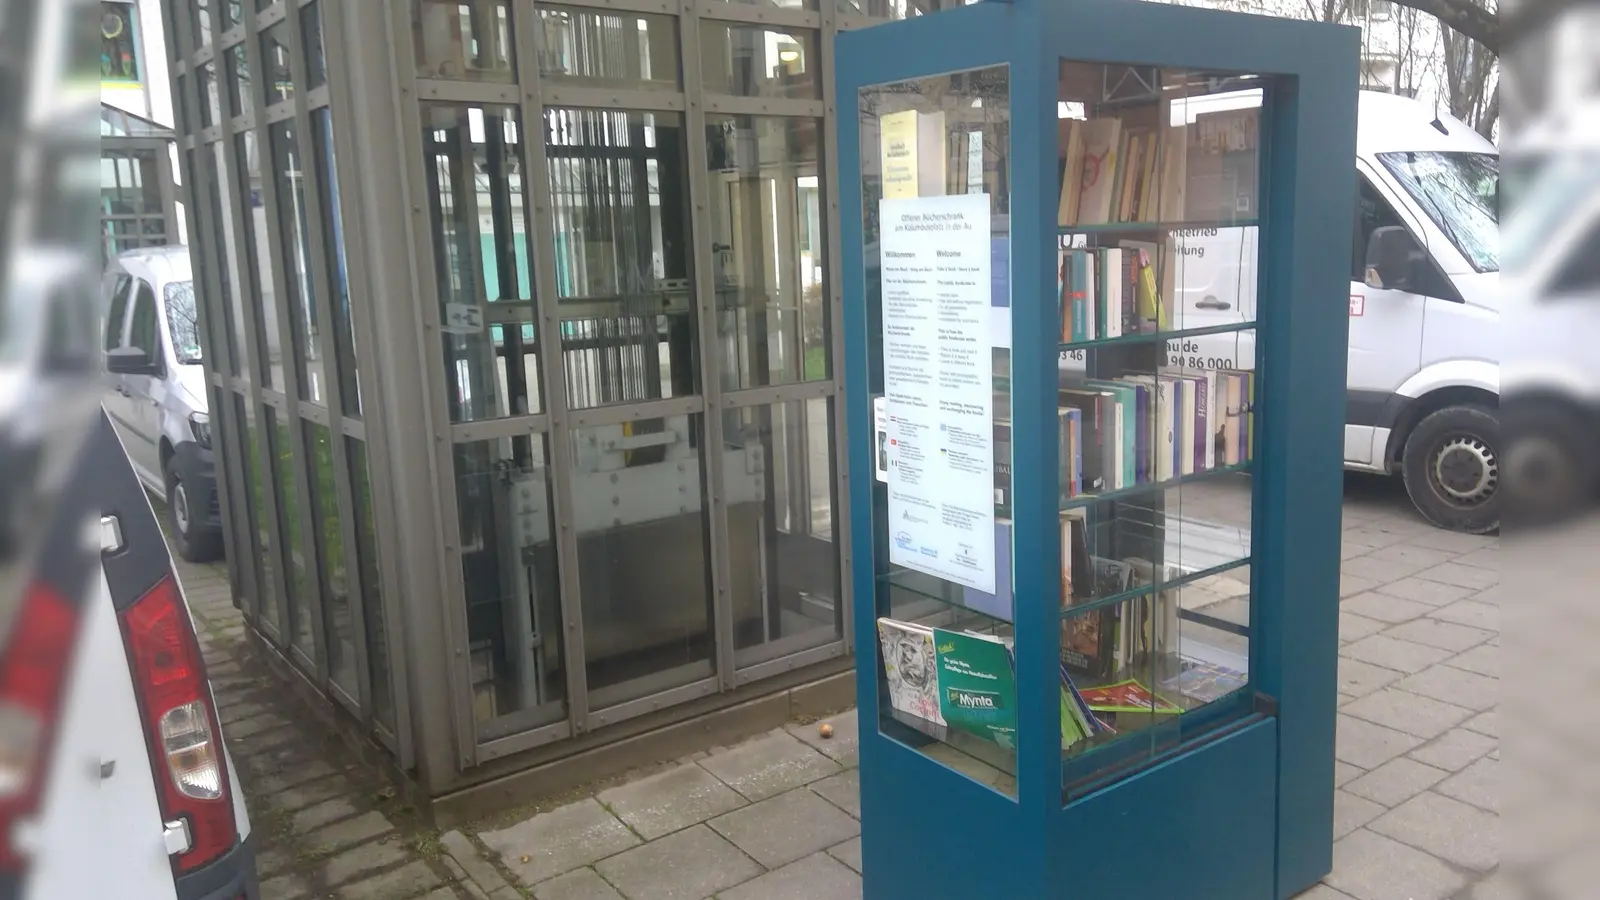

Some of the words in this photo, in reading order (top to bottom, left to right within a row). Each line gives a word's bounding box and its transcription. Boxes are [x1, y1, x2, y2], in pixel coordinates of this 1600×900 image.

[884, 250, 916, 258] Willkommen
[936, 249, 962, 258] Welcome
[1188, 356, 1204, 369] 86
[1207, 357, 1232, 371] 000
[959, 693, 995, 709] Mynta
